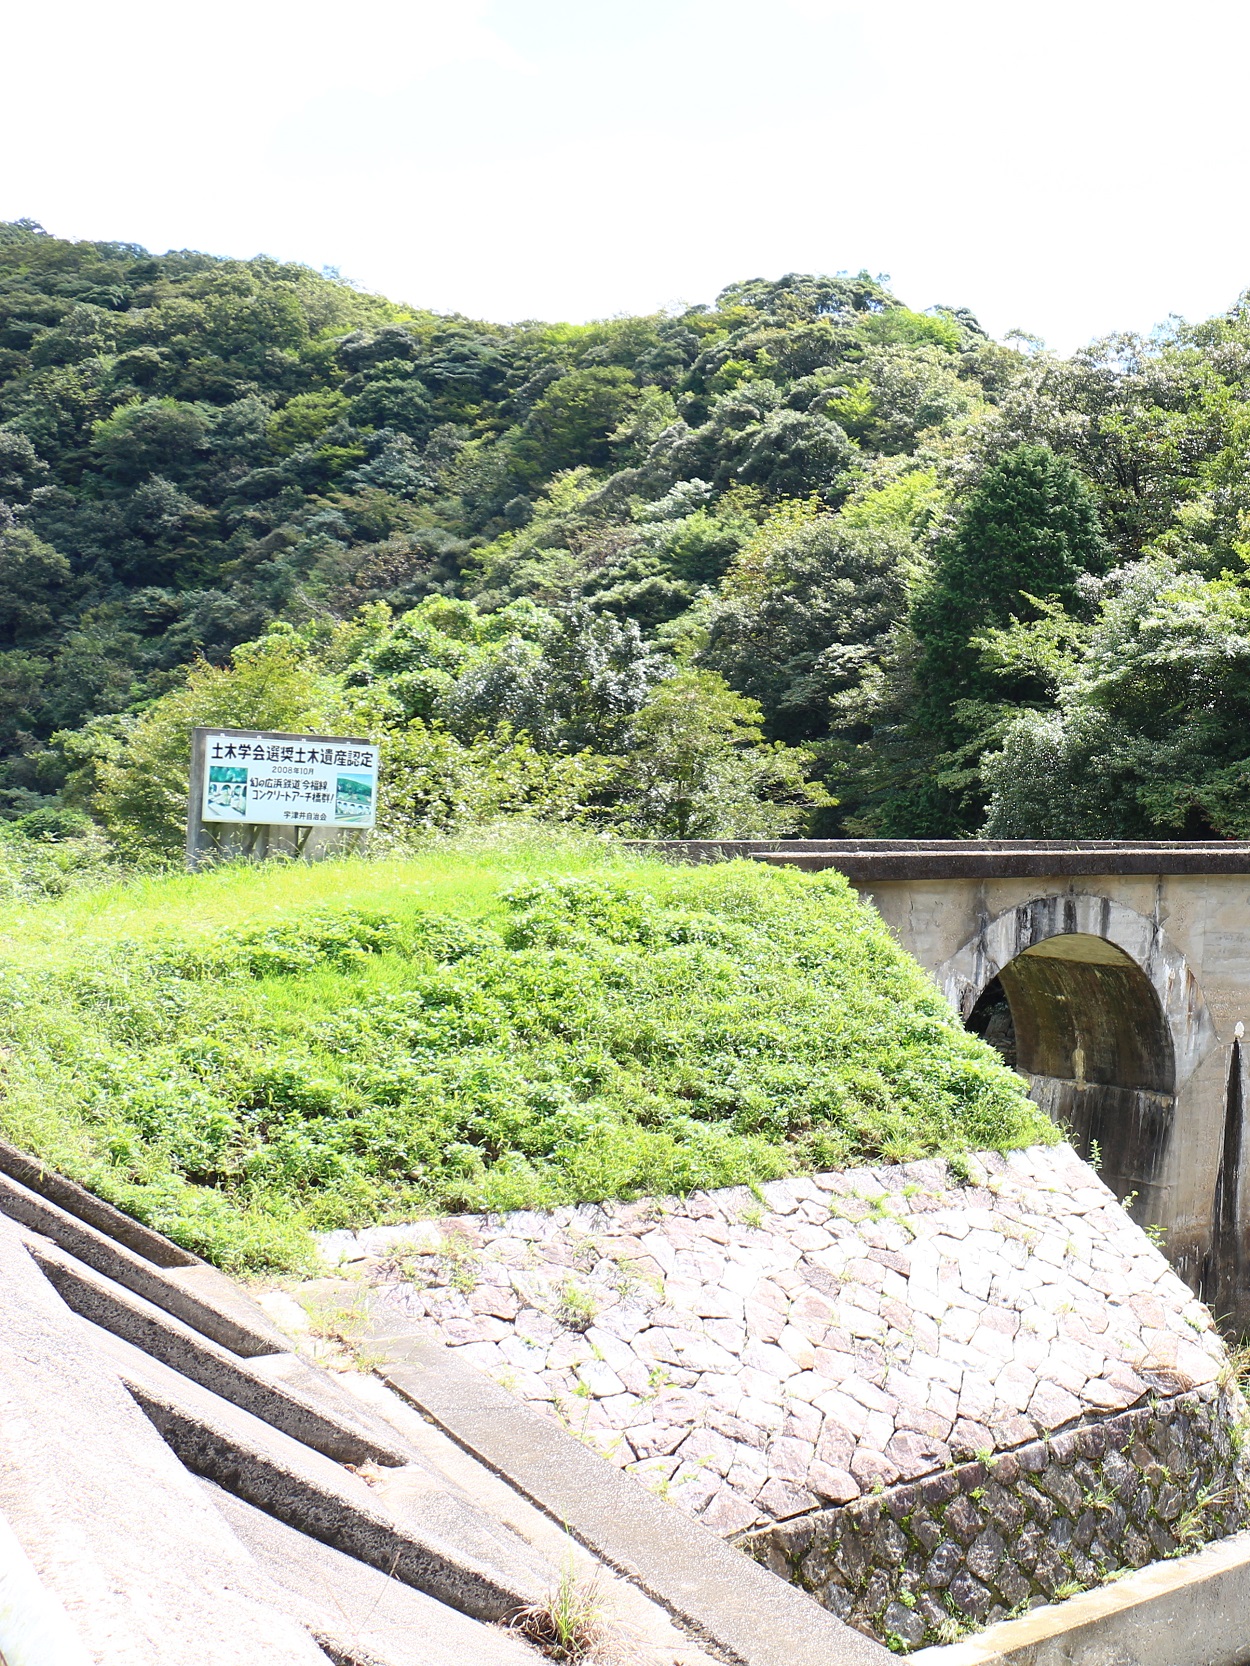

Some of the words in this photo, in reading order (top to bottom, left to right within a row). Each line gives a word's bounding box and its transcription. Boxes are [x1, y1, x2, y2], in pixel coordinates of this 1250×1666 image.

[211, 743, 374, 768] 土木学会選奨土木遺産認定
[271, 765, 314, 776] 2008年10月
[283, 811, 327, 821] 宇津井自治会
